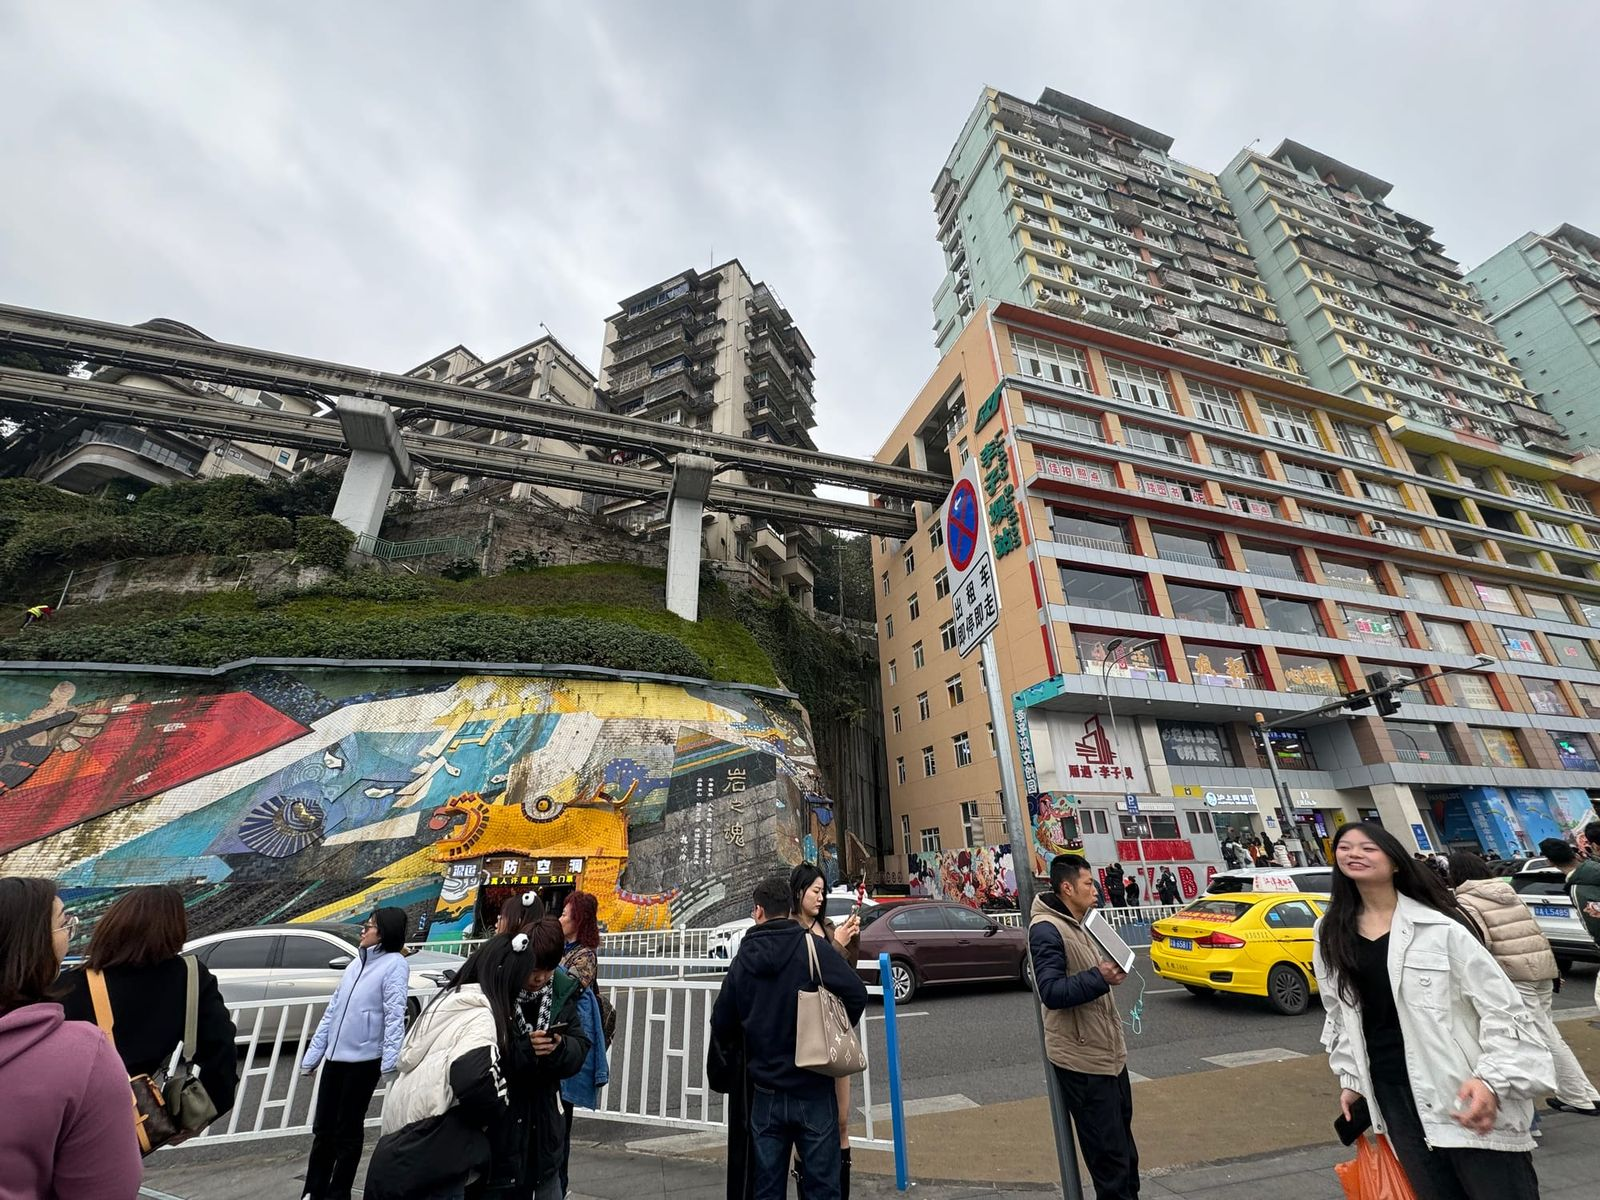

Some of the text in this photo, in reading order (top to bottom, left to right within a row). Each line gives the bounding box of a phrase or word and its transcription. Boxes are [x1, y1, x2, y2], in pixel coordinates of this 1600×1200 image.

[955, 563, 990, 621] 出租车
[957, 593, 995, 647] 即停即走
[1127, 795, 1135, 806] P
[502, 859, 583, 875] 防空洞
